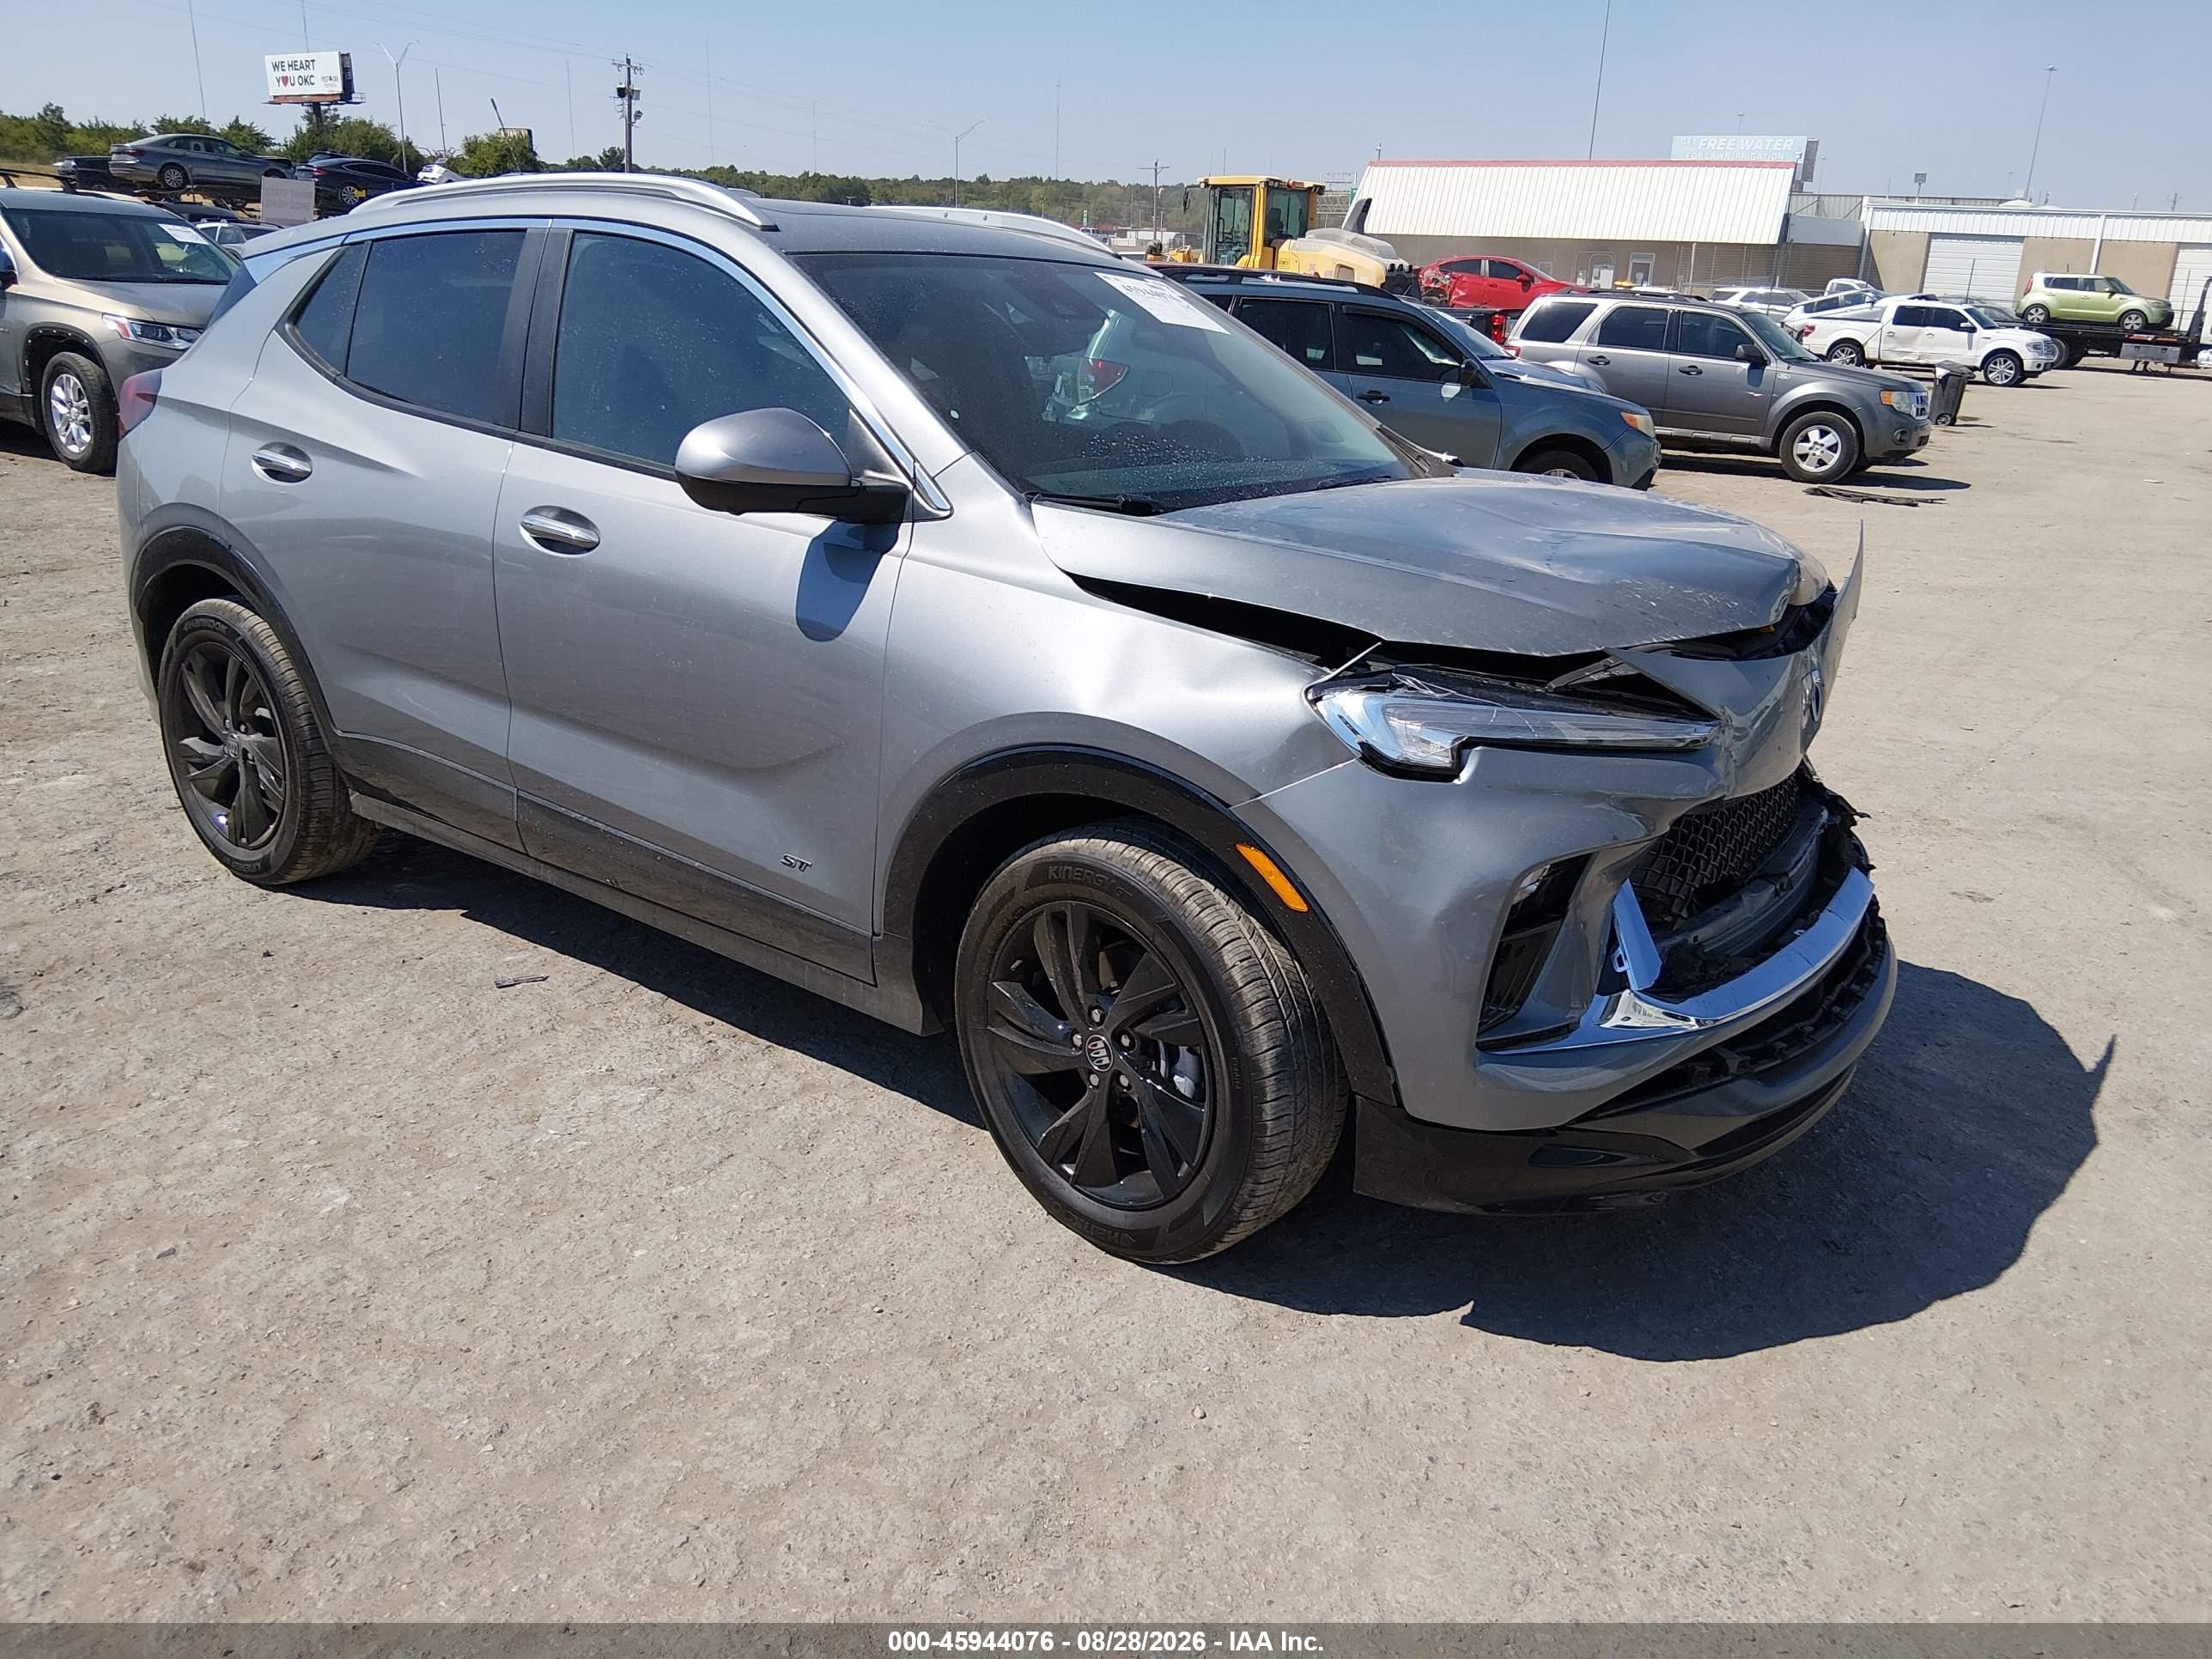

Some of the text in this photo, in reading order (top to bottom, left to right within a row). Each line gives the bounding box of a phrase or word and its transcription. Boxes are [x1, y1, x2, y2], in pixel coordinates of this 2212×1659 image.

[271, 59, 315, 72] WE HEART
[297, 75, 315, 86] OKC
[1697, 137, 1736, 150] FREE
[1740, 138, 1794, 151] WATER
[1732, 152, 1785, 161] IRRIGATION
[780, 854, 812, 872] ST
